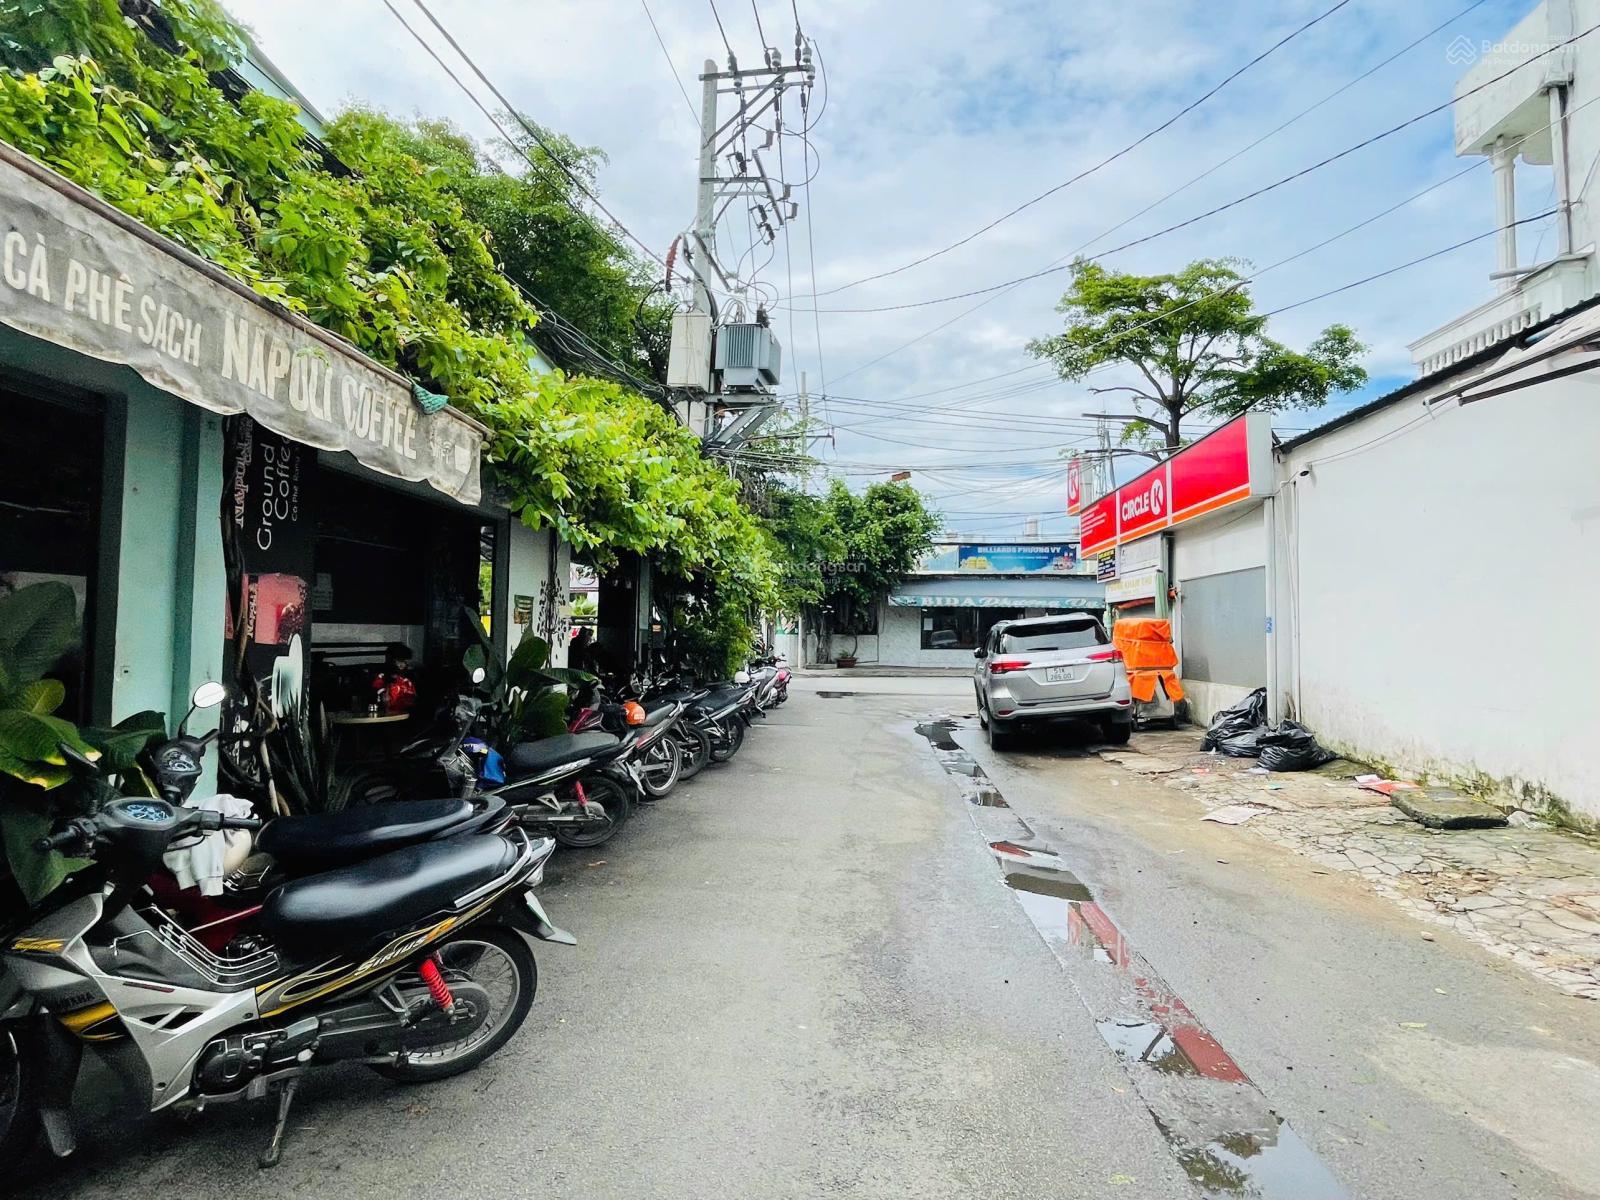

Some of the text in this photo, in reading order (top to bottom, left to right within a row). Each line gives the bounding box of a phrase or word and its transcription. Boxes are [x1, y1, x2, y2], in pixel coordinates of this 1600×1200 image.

[4, 232, 50, 303] CÀ
[64, 259, 134, 334] PHÊ
[222, 310, 334, 423] NAPOLI
[342, 374, 418, 461] COFFEE
[256, 443, 276, 550] Ground
[1122, 491, 1149, 522] CIRCLE
[1151, 480, 1163, 514] K
[922, 597, 975, 607] BIDA
